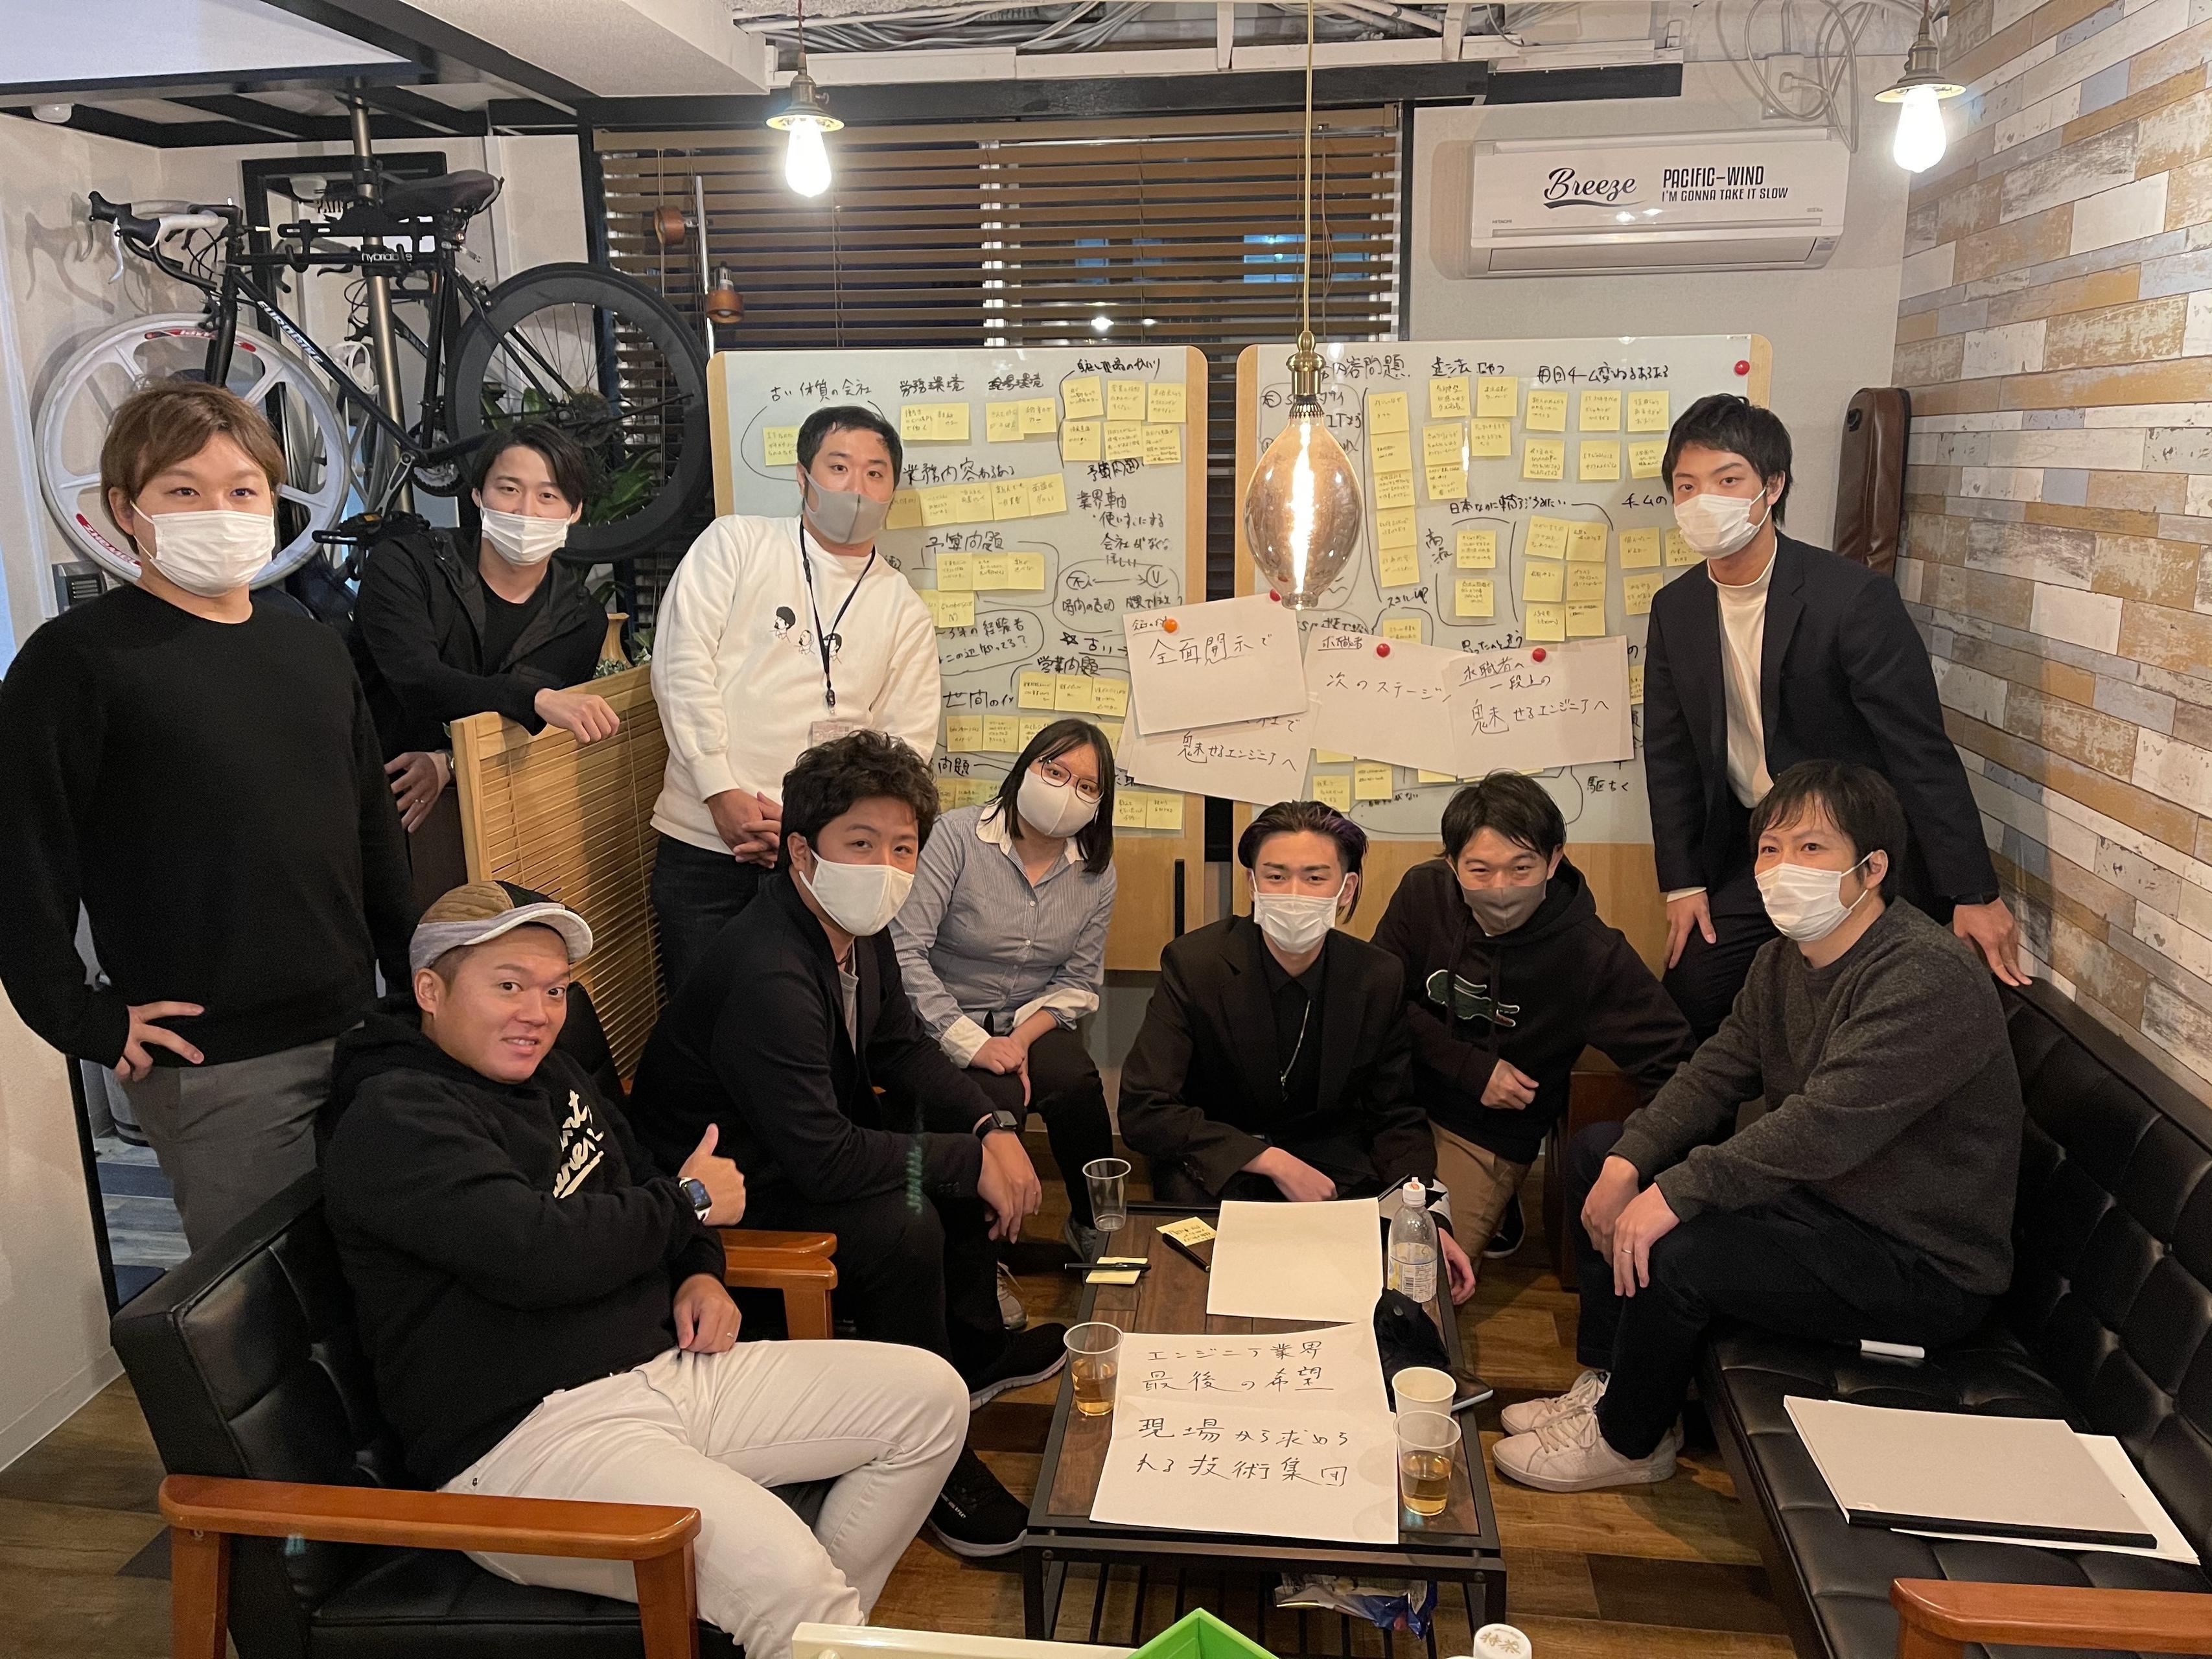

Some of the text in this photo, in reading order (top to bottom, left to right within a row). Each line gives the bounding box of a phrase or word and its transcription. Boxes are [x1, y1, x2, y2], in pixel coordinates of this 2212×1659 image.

[1543, 167, 1637, 202] Breeze
[1662, 165, 1765, 188] PACIFIC-WIND
[1662, 187, 1789, 202] I'M GONNA TAKE IT SLOW
[1149, 632, 1273, 666] 全面開示で
[1489, 675, 1551, 690] 一段上の
[1471, 698, 1609, 736] 魅せるエンジニアへ
[1177, 730, 1297, 772] 魅せるエンジニアへ
[1147, 1340, 1322, 1361] エンジニア業界
[1142, 1365, 1334, 1392] 最後の希望
[1138, 1417, 1349, 1448] 現場から求めら
[1137, 1453, 1348, 1487] れる技術集団
